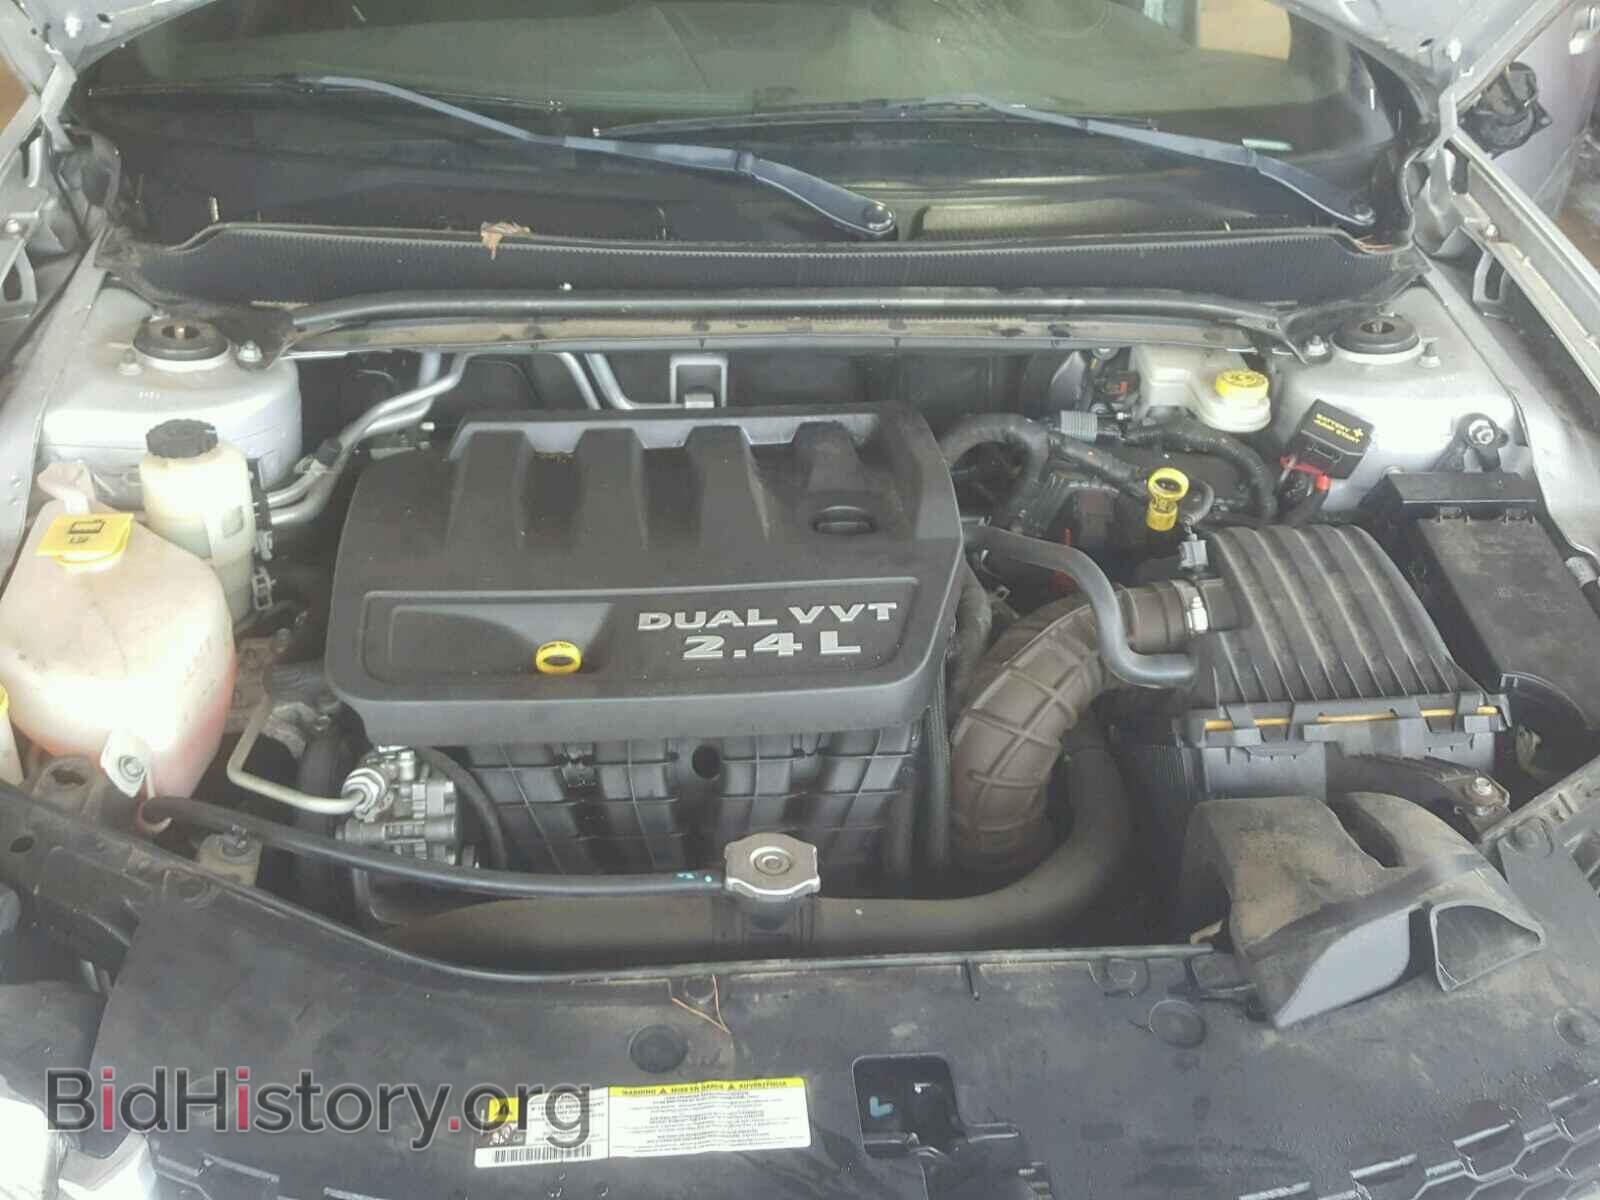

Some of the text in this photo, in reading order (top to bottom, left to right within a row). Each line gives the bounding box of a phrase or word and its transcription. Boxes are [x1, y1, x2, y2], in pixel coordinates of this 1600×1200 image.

[638, 602, 897, 630] DUAL VVT
[683, 631, 861, 660] 2.4 L
